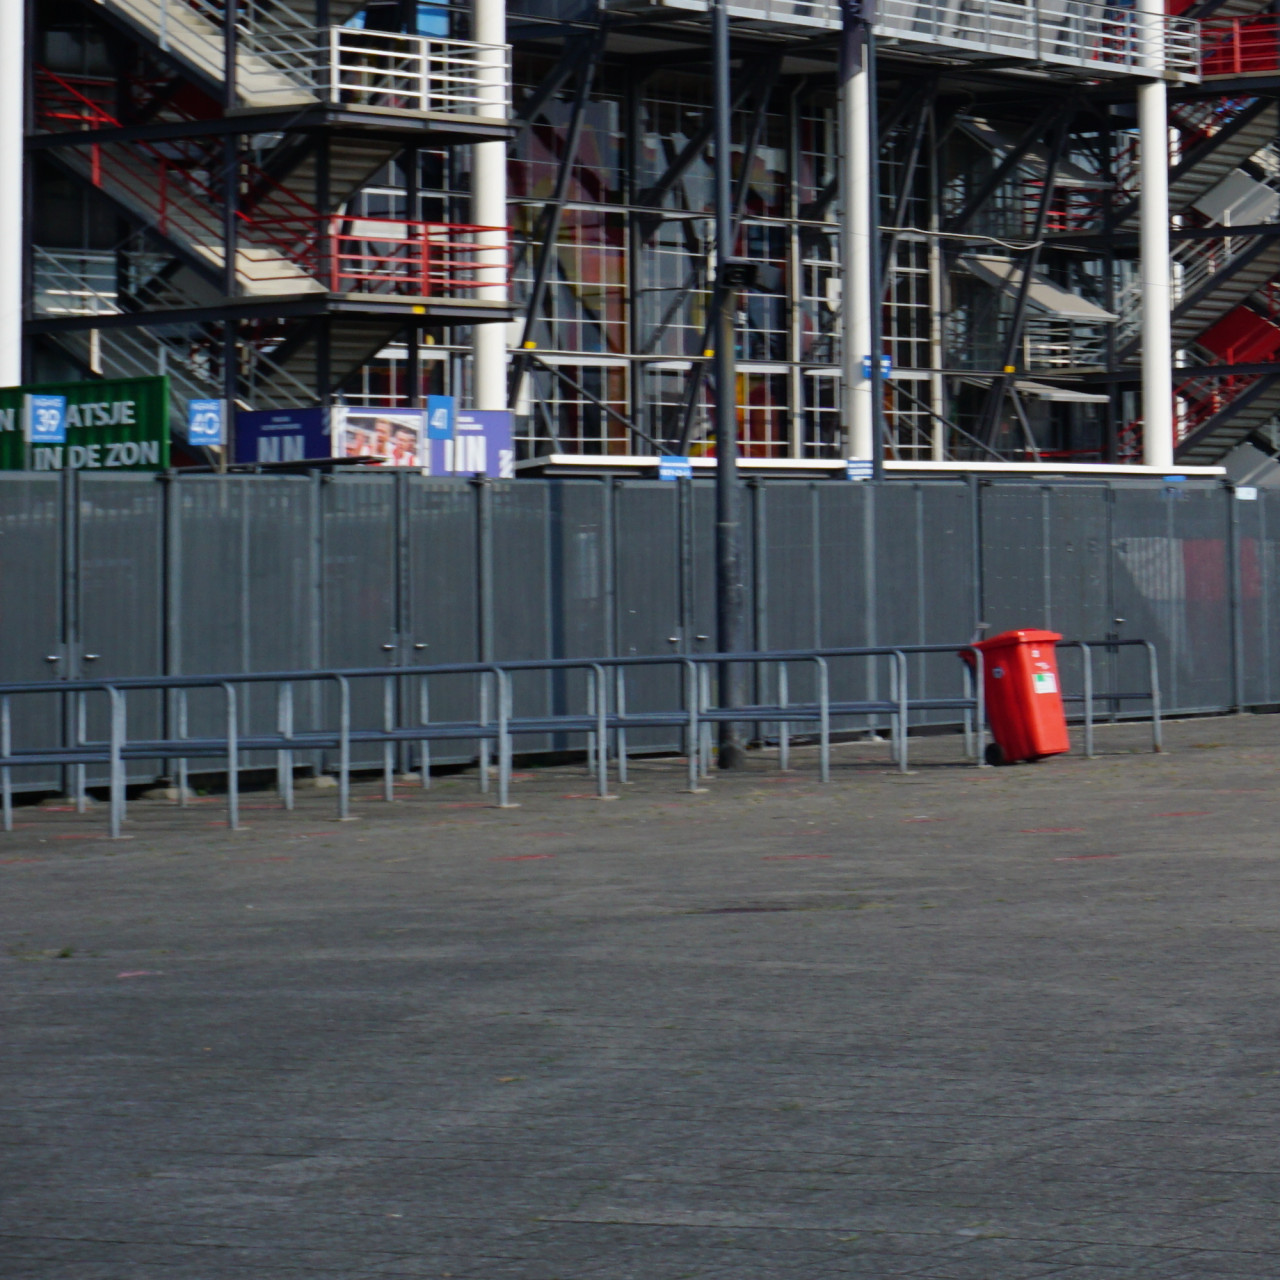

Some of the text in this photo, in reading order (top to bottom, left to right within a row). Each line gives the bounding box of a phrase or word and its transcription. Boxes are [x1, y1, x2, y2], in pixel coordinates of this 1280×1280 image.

[36, 408, 61, 432] 39
[190, 412, 220, 435] 40
[35, 441, 159, 469] IN DE ZON
